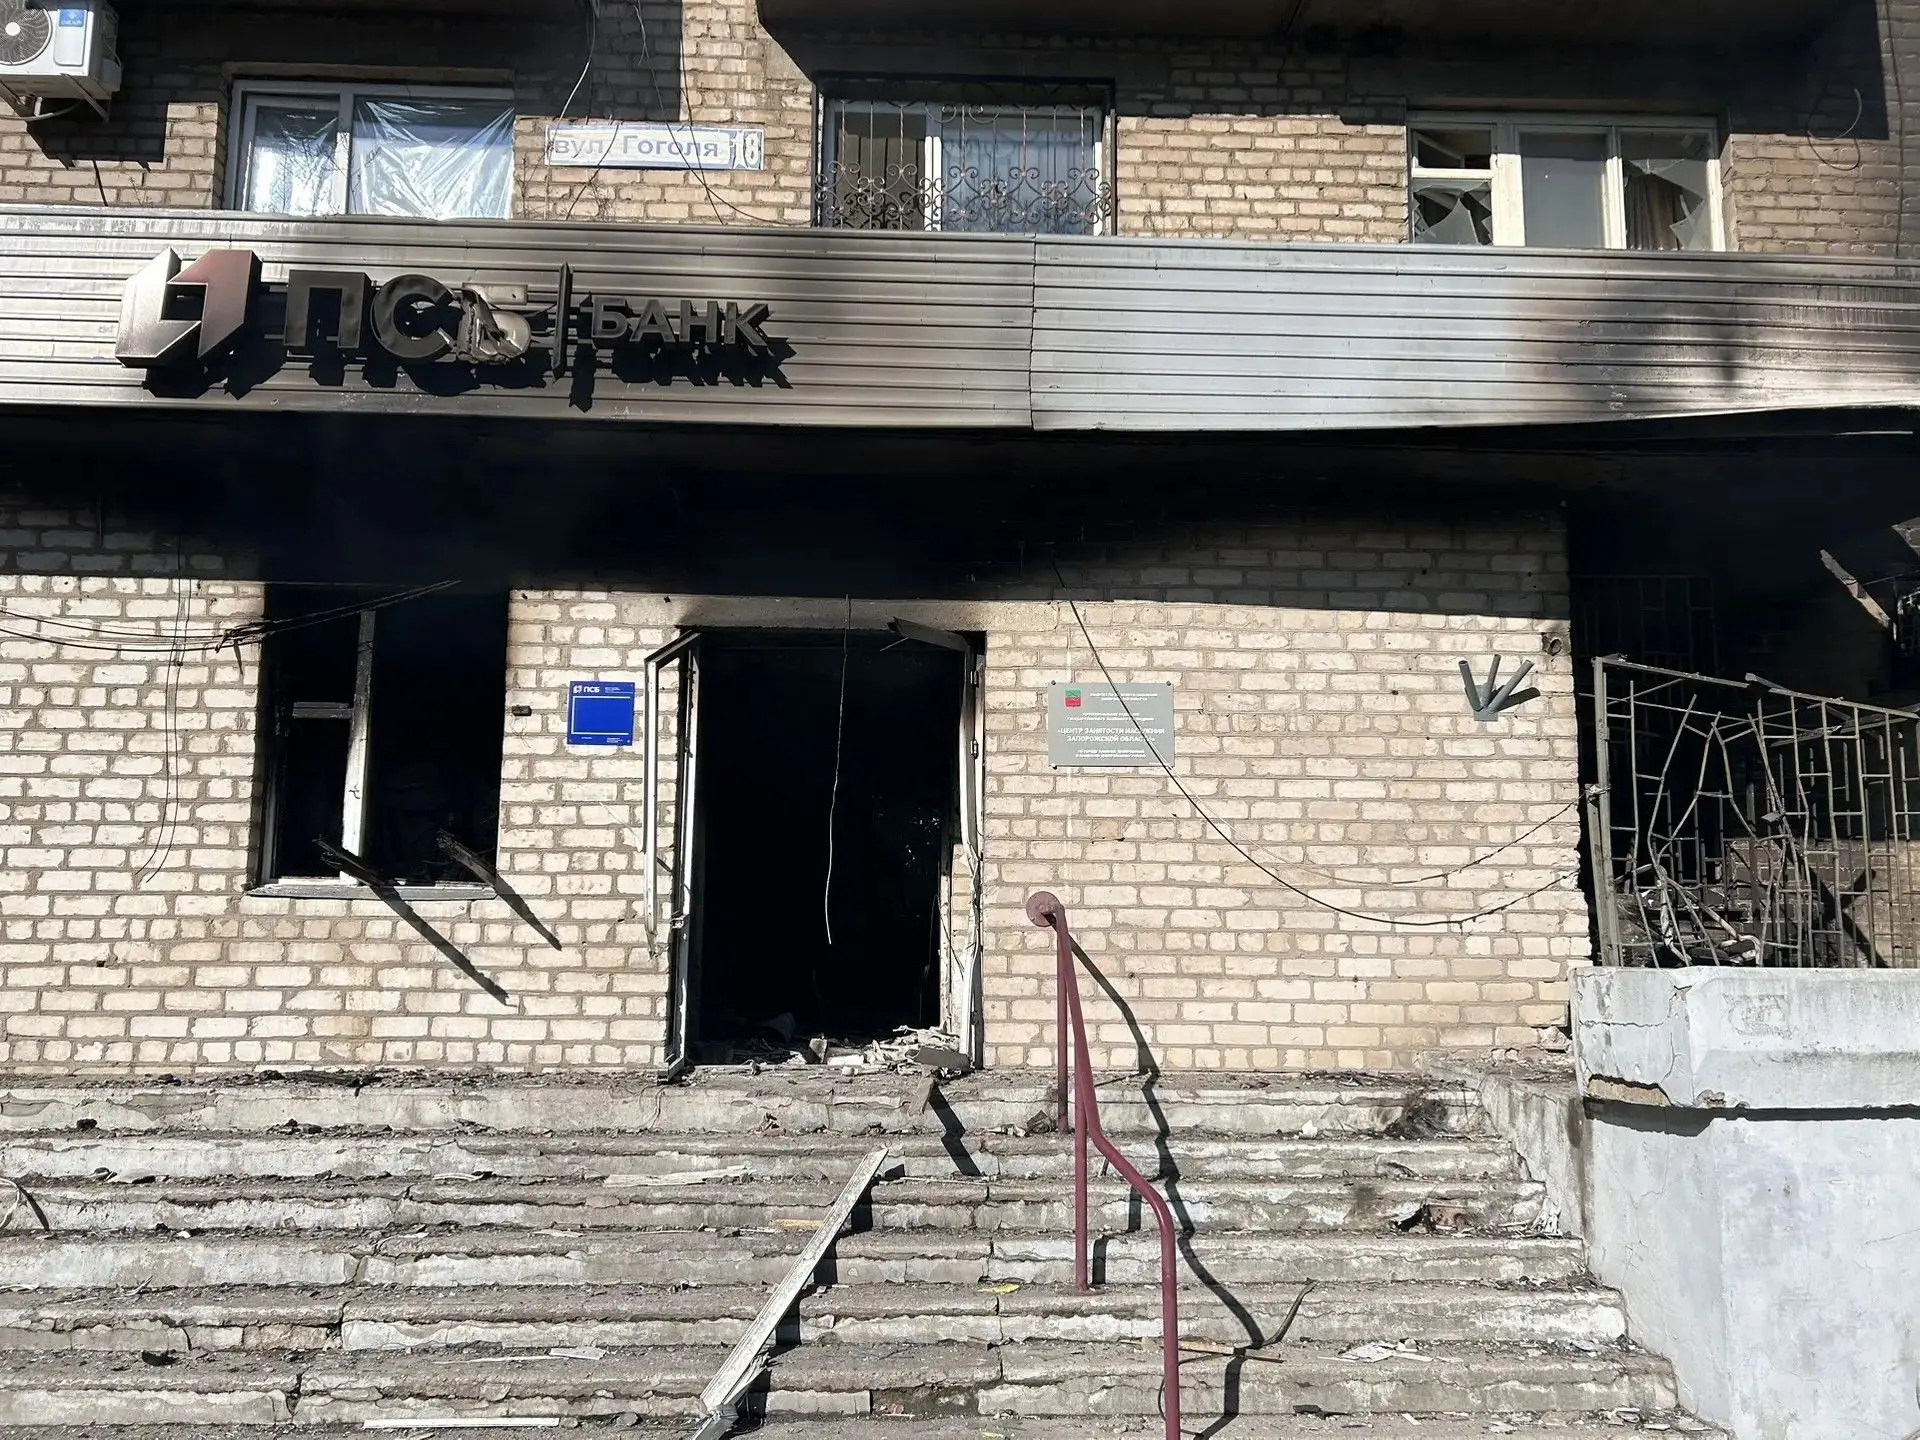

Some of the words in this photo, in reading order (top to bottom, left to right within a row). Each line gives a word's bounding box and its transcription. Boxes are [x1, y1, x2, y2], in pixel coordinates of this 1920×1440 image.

[623, 135, 719, 157] Гоголя
[730, 130, 761, 169] 18
[591, 298, 772, 348] БАНК
[1066, 734, 1119, 742] ЗАПОРОЖСКОЙ
